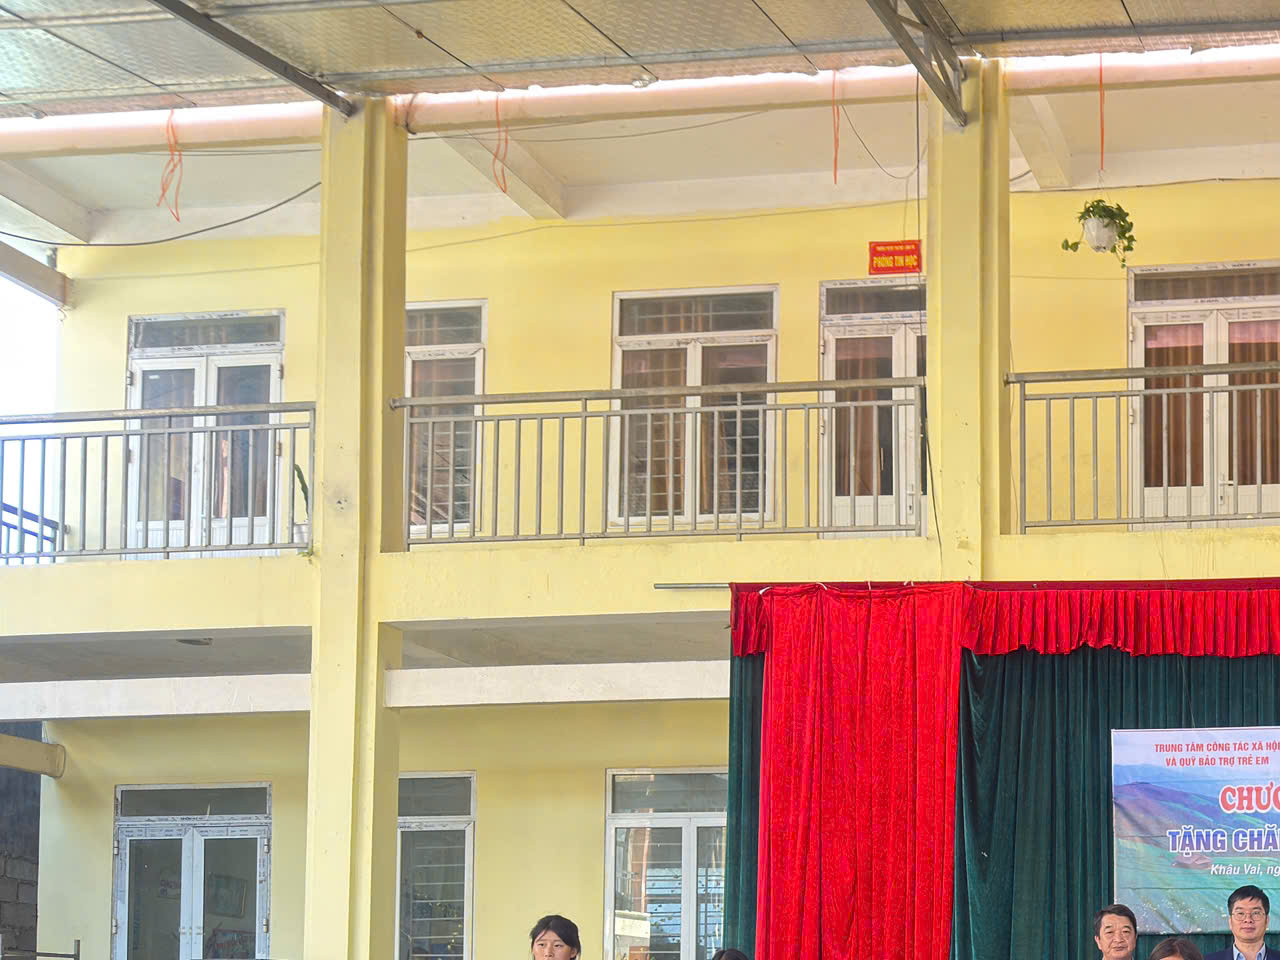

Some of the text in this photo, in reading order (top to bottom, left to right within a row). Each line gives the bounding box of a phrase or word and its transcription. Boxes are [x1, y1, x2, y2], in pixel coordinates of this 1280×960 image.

[1155, 740, 1280, 752] TRUNG TÂM CÔNG TÁC XÃ HỘI
[1166, 756, 1176, 766] VÀ
[1199, 755, 1216, 766] BẢO
[1219, 756, 1234, 767] TRỢ
[1256, 756, 1269, 765] EM
[1167, 825, 1227, 856] TẶNG
[1211, 864, 1240, 875] Khâu
[1243, 864, 1263, 876] Vai,
